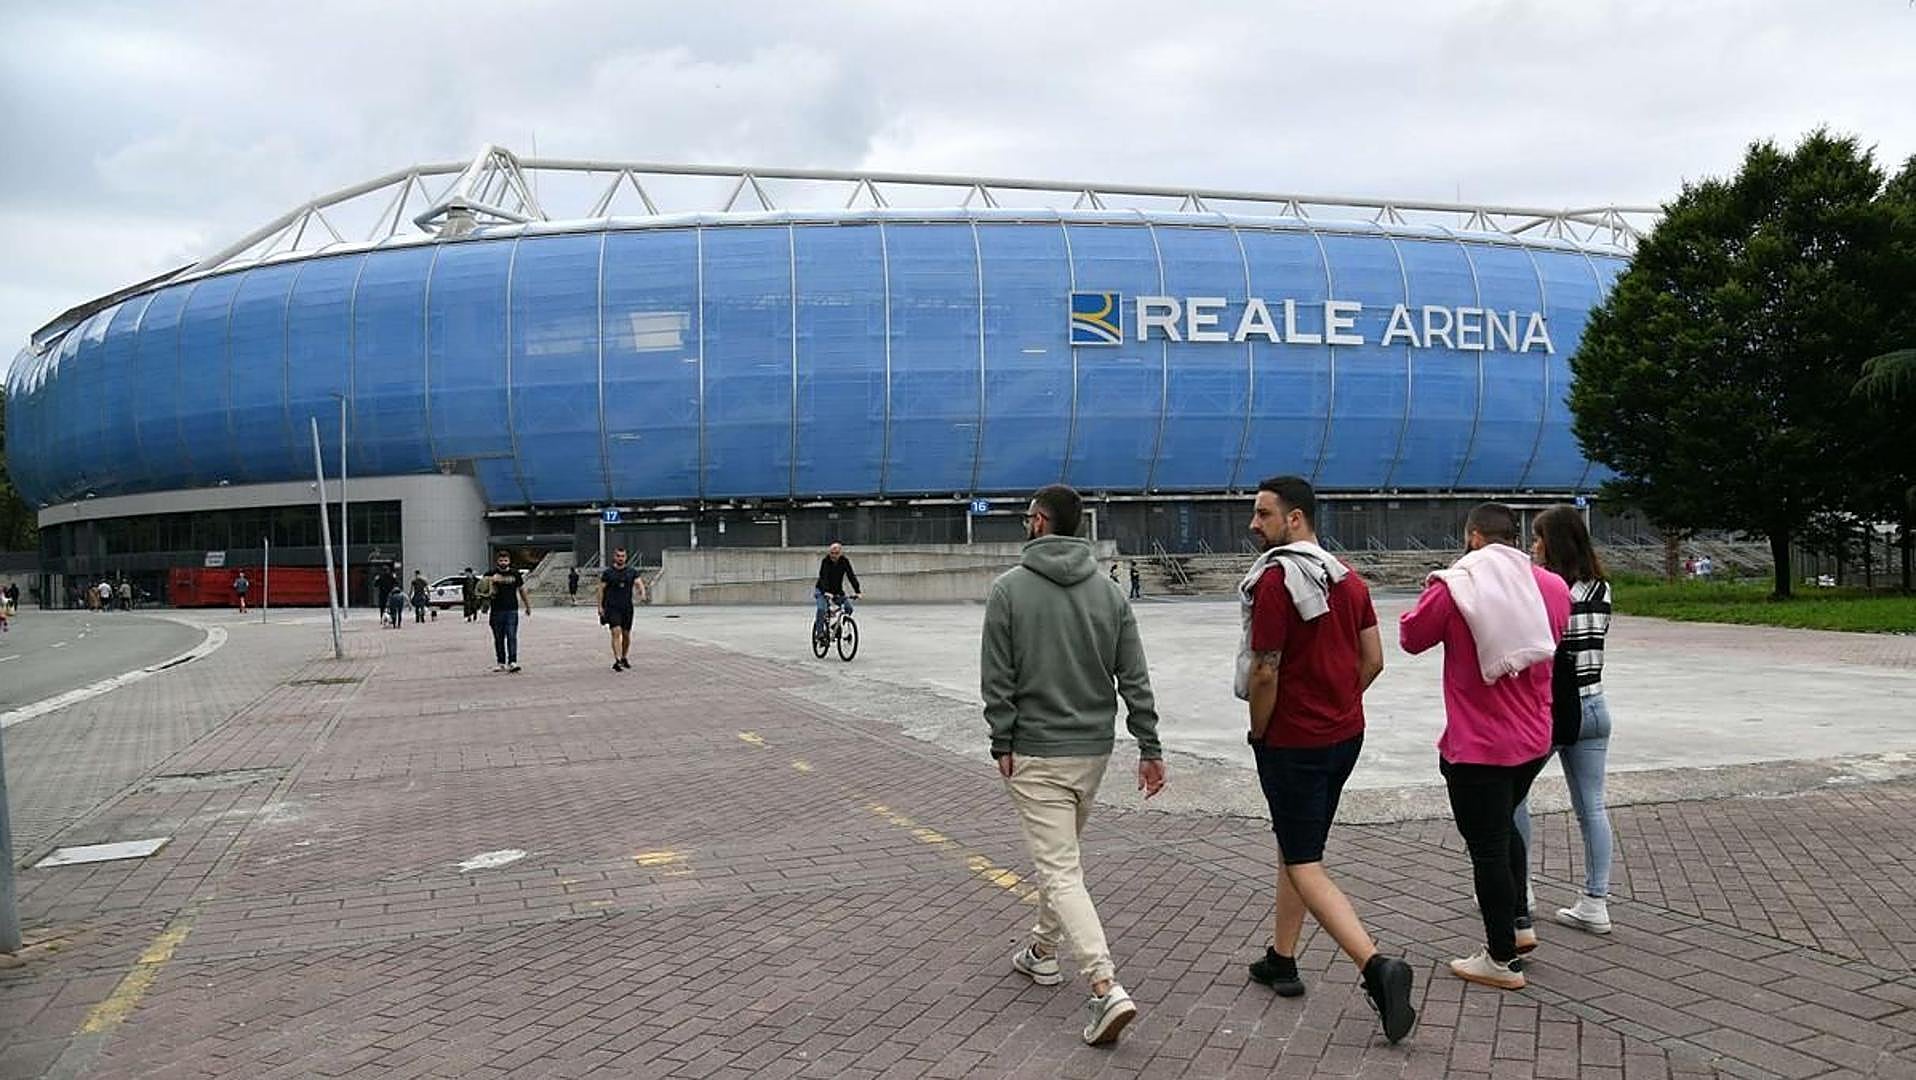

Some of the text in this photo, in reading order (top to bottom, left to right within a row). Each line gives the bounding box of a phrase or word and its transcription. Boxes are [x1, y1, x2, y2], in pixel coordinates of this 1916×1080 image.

[1136, 296, 1556, 354] REALE ARENA
[972, 501, 987, 512] 16
[606, 511, 618, 521] 17
